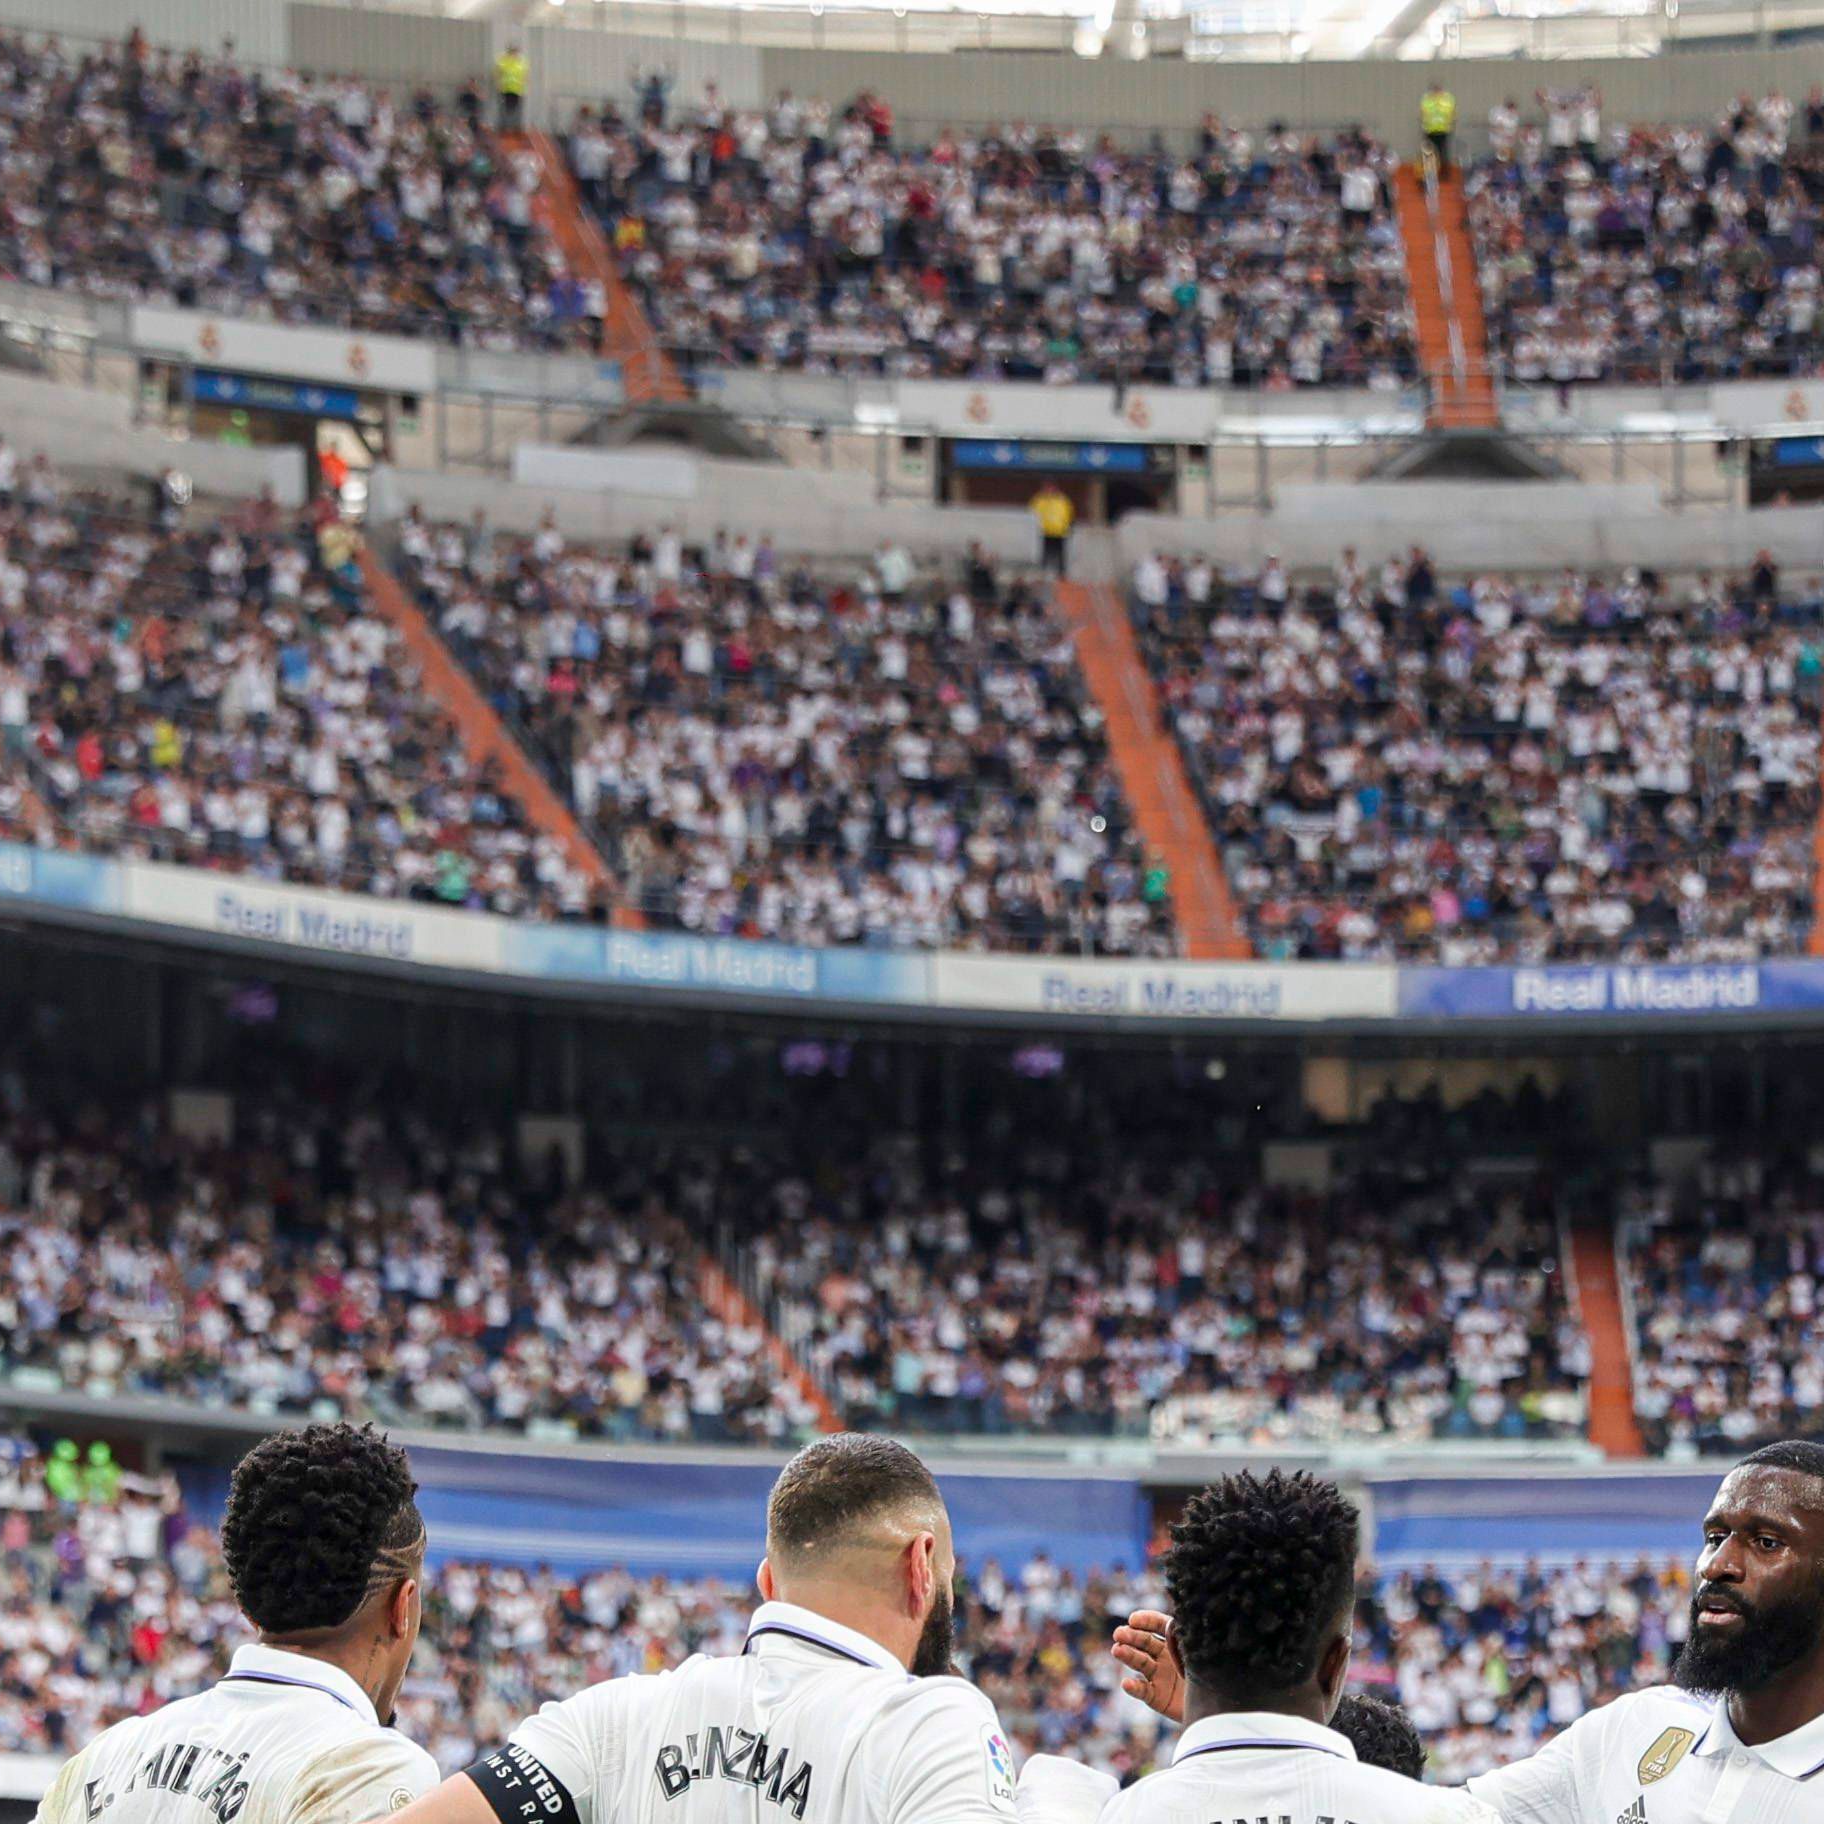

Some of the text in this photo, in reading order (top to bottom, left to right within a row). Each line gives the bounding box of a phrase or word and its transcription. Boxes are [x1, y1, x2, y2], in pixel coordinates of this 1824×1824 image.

[216, 893, 413, 958] Real Madrid
[606, 934, 816, 990] Real Madrid
[1514, 966, 1759, 1012] Real Madrid
[1043, 974, 1282, 1014] Real Madrid
[507, 1745, 563, 1814] UNITED
